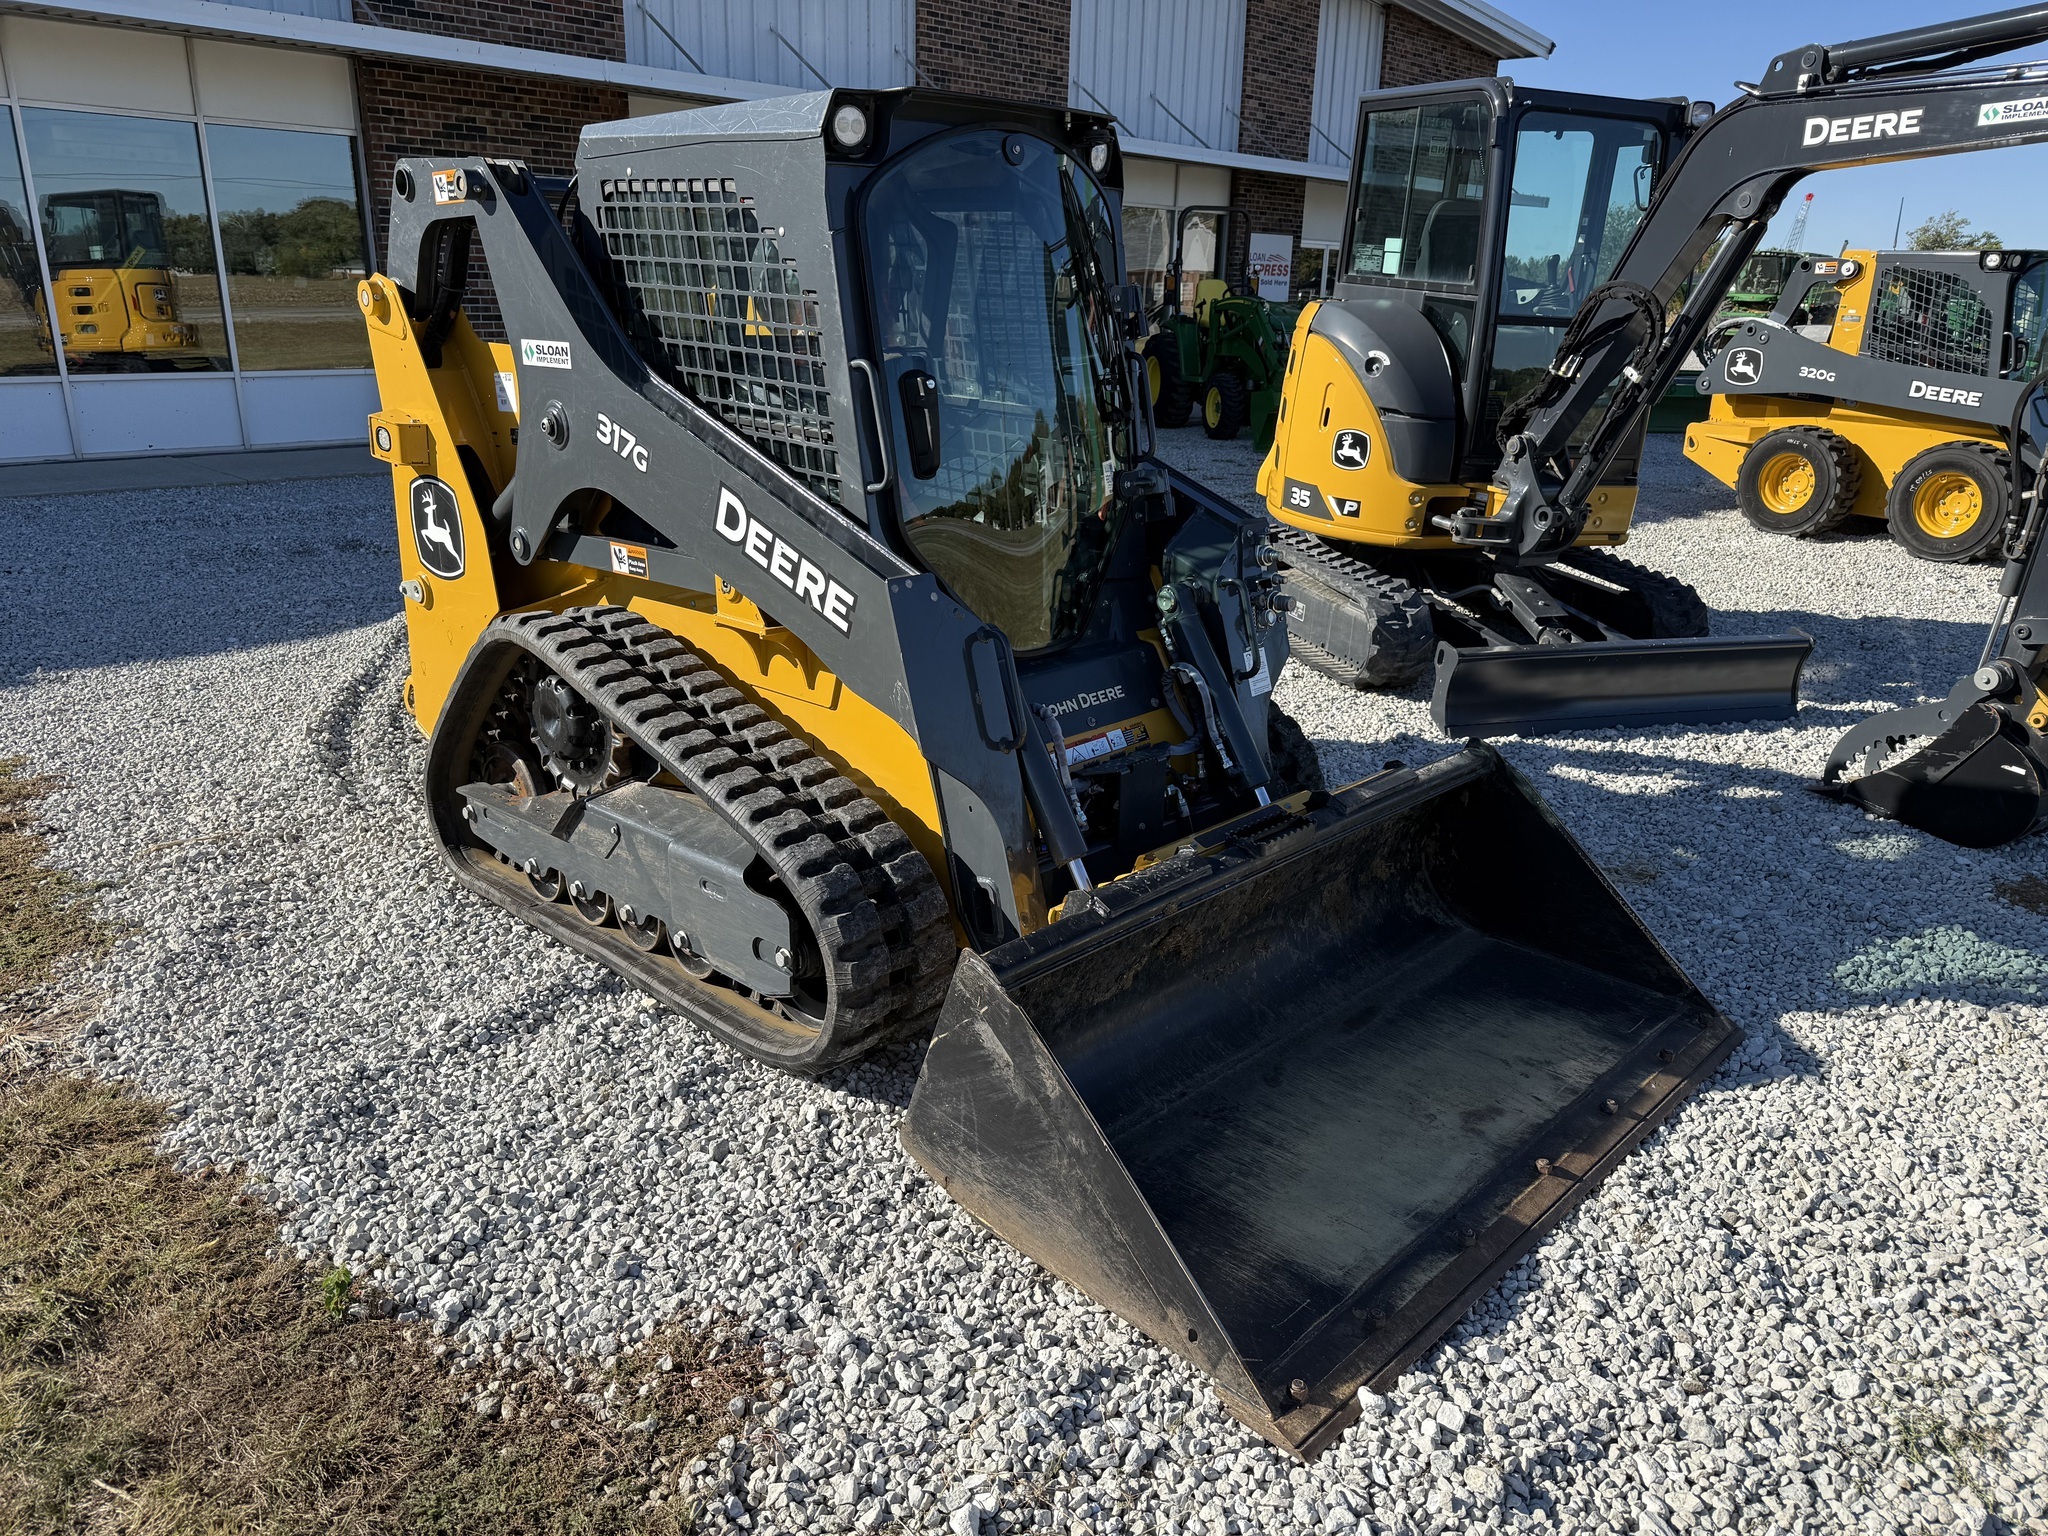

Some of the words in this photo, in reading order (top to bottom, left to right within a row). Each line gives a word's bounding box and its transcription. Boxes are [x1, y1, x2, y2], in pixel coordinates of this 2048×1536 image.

[1802, 108, 1924, 147] DEERE
[535, 344, 569, 357] SLOAN
[536, 356, 569, 365] IMPLEMENT
[1799, 366, 1836, 382] 320G
[1908, 380, 1983, 407] DEERE
[596, 412, 649, 473] 317G
[1290, 486, 1311, 508] 35
[1342, 500, 1358, 515] P
[715, 485, 855, 633] DEERE
[1043, 697, 1079, 717] OHN
[1077, 685, 1125, 709] DEERE
